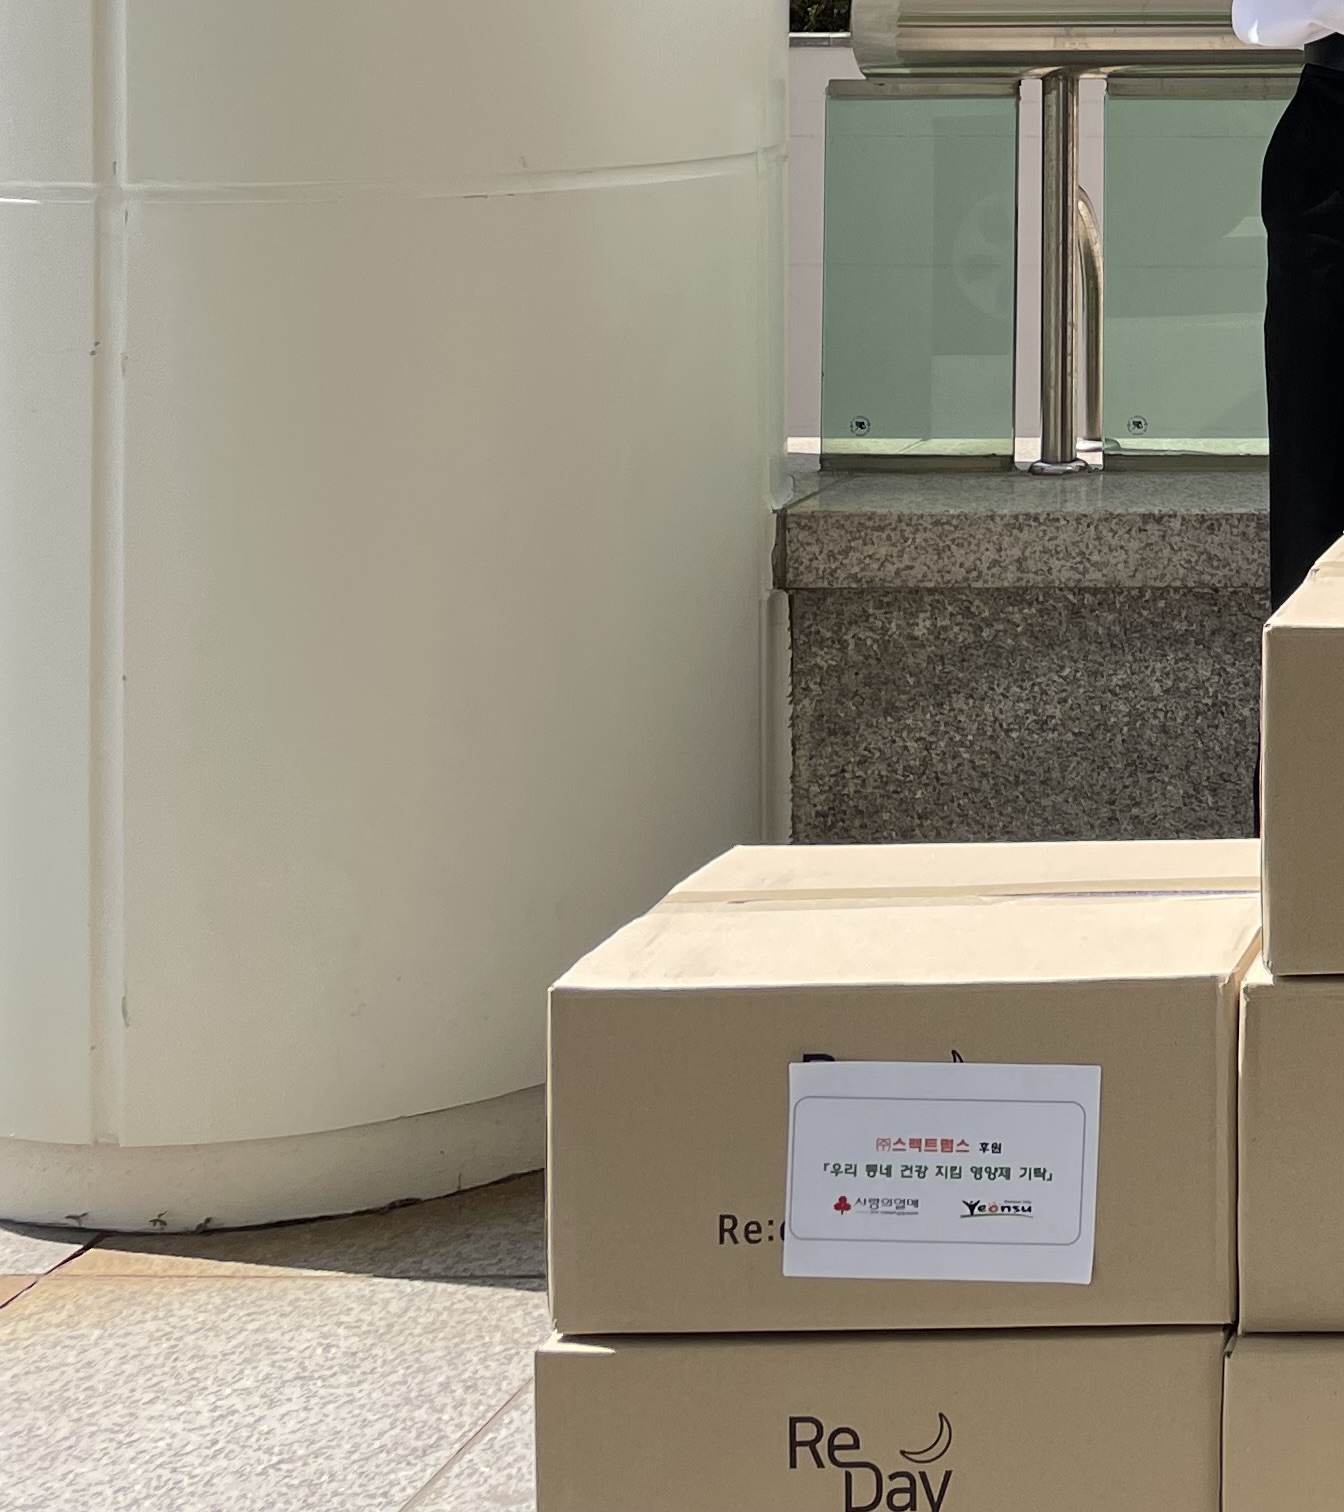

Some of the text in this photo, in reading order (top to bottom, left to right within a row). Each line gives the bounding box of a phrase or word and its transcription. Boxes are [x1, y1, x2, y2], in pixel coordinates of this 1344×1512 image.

[979, 1142, 1002, 1154] 후원
[900, 1164, 928, 1179] 건강
[970, 1166, 1011, 1180] 영양제
[855, 1197, 919, 1210] 사랑의열매
[962, 1200, 1032, 1216] Yeonsu
[788, 1416, 860, 1469] Re
